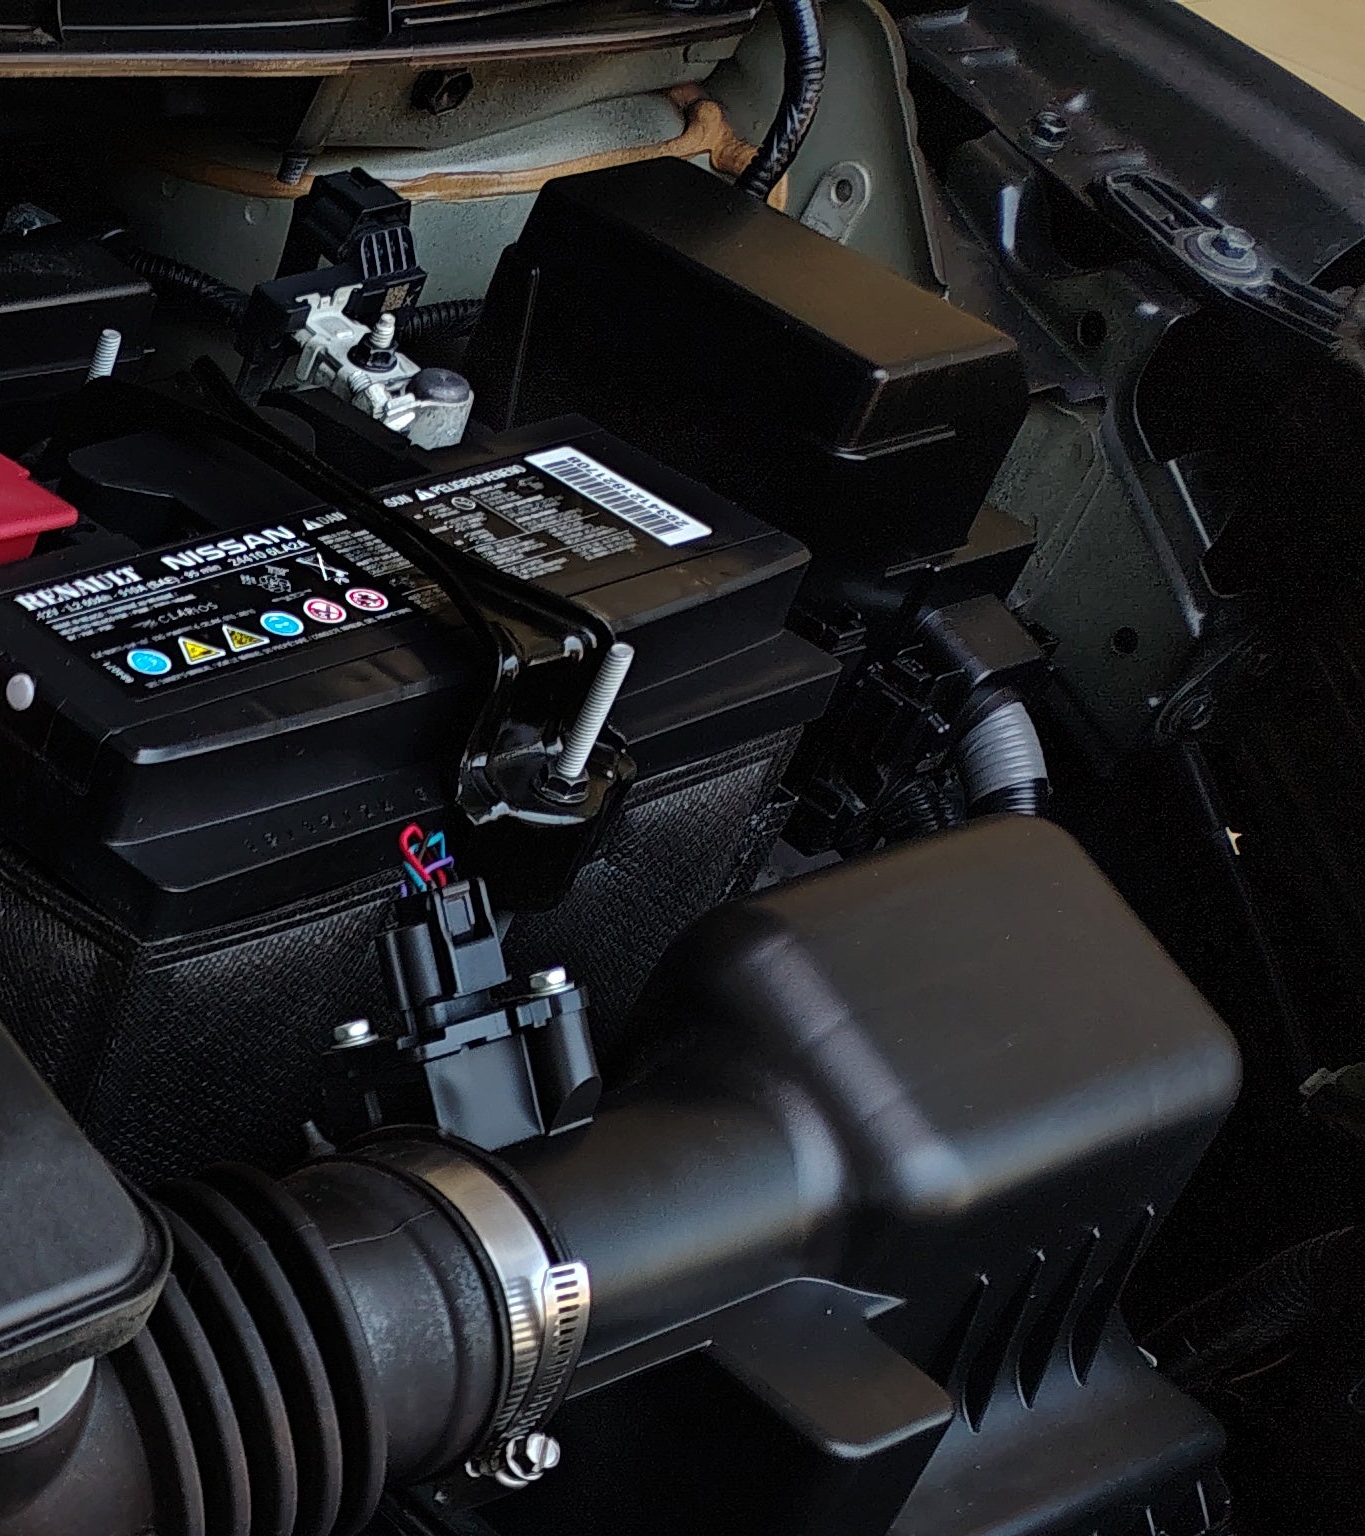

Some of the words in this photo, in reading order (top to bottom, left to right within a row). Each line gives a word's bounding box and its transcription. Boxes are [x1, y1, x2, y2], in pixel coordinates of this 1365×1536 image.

[567, 454, 690, 530] 2934121821708
[12, 564, 144, 611] RENAULT
[159, 524, 296, 570] NISSAN
